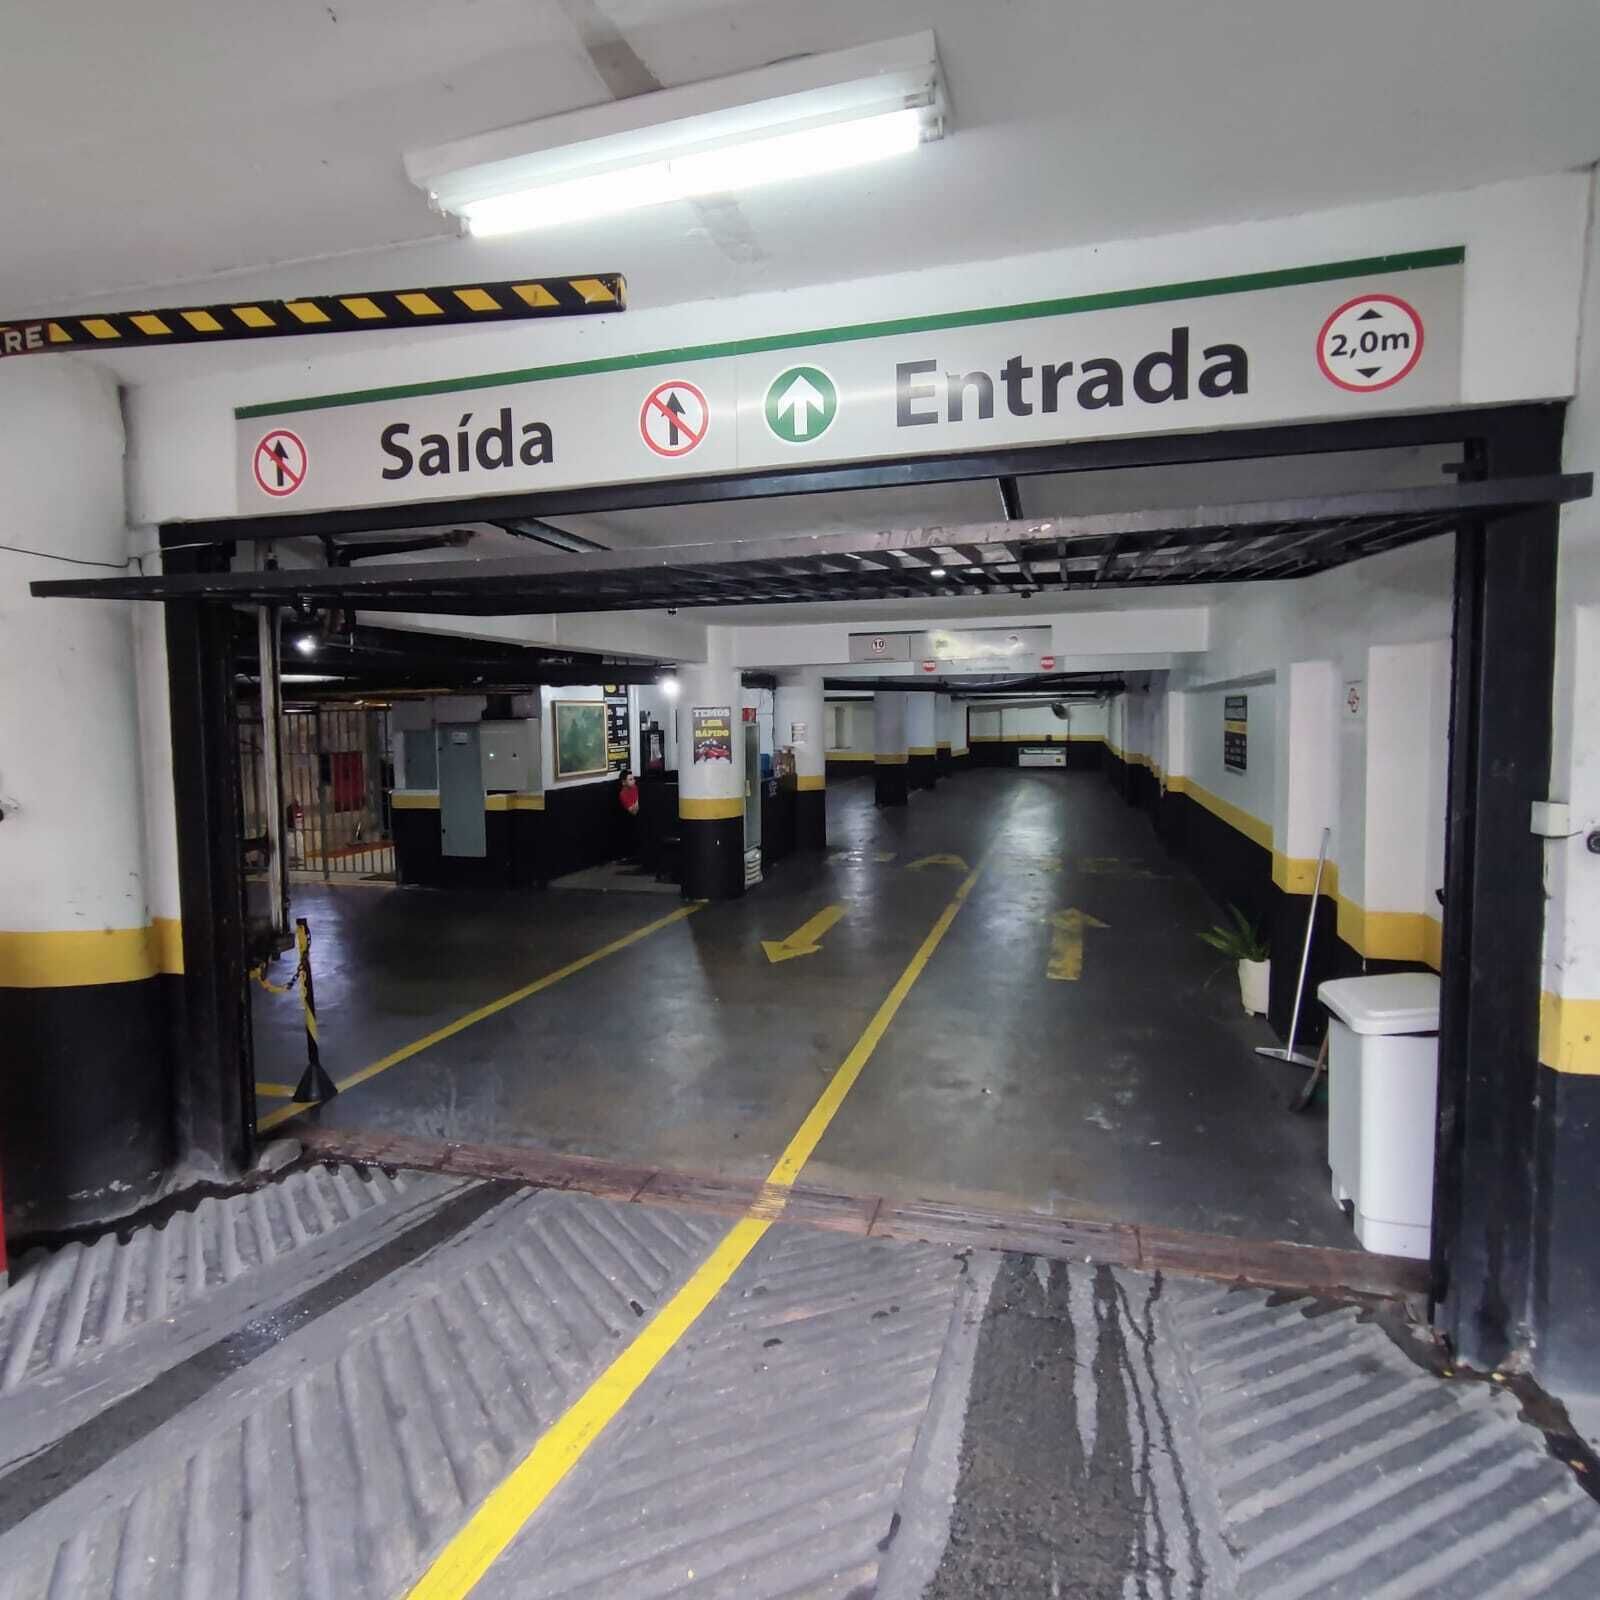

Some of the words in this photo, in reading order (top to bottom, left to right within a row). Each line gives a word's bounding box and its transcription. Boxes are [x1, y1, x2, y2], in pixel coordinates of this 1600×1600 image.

[0, 325, 44, 354] RE
[1329, 327, 1411, 358] 2,0m
[895, 327, 1250, 428] Entrada
[381, 407, 555, 481] Saída
[873, 639, 885, 649] 10
